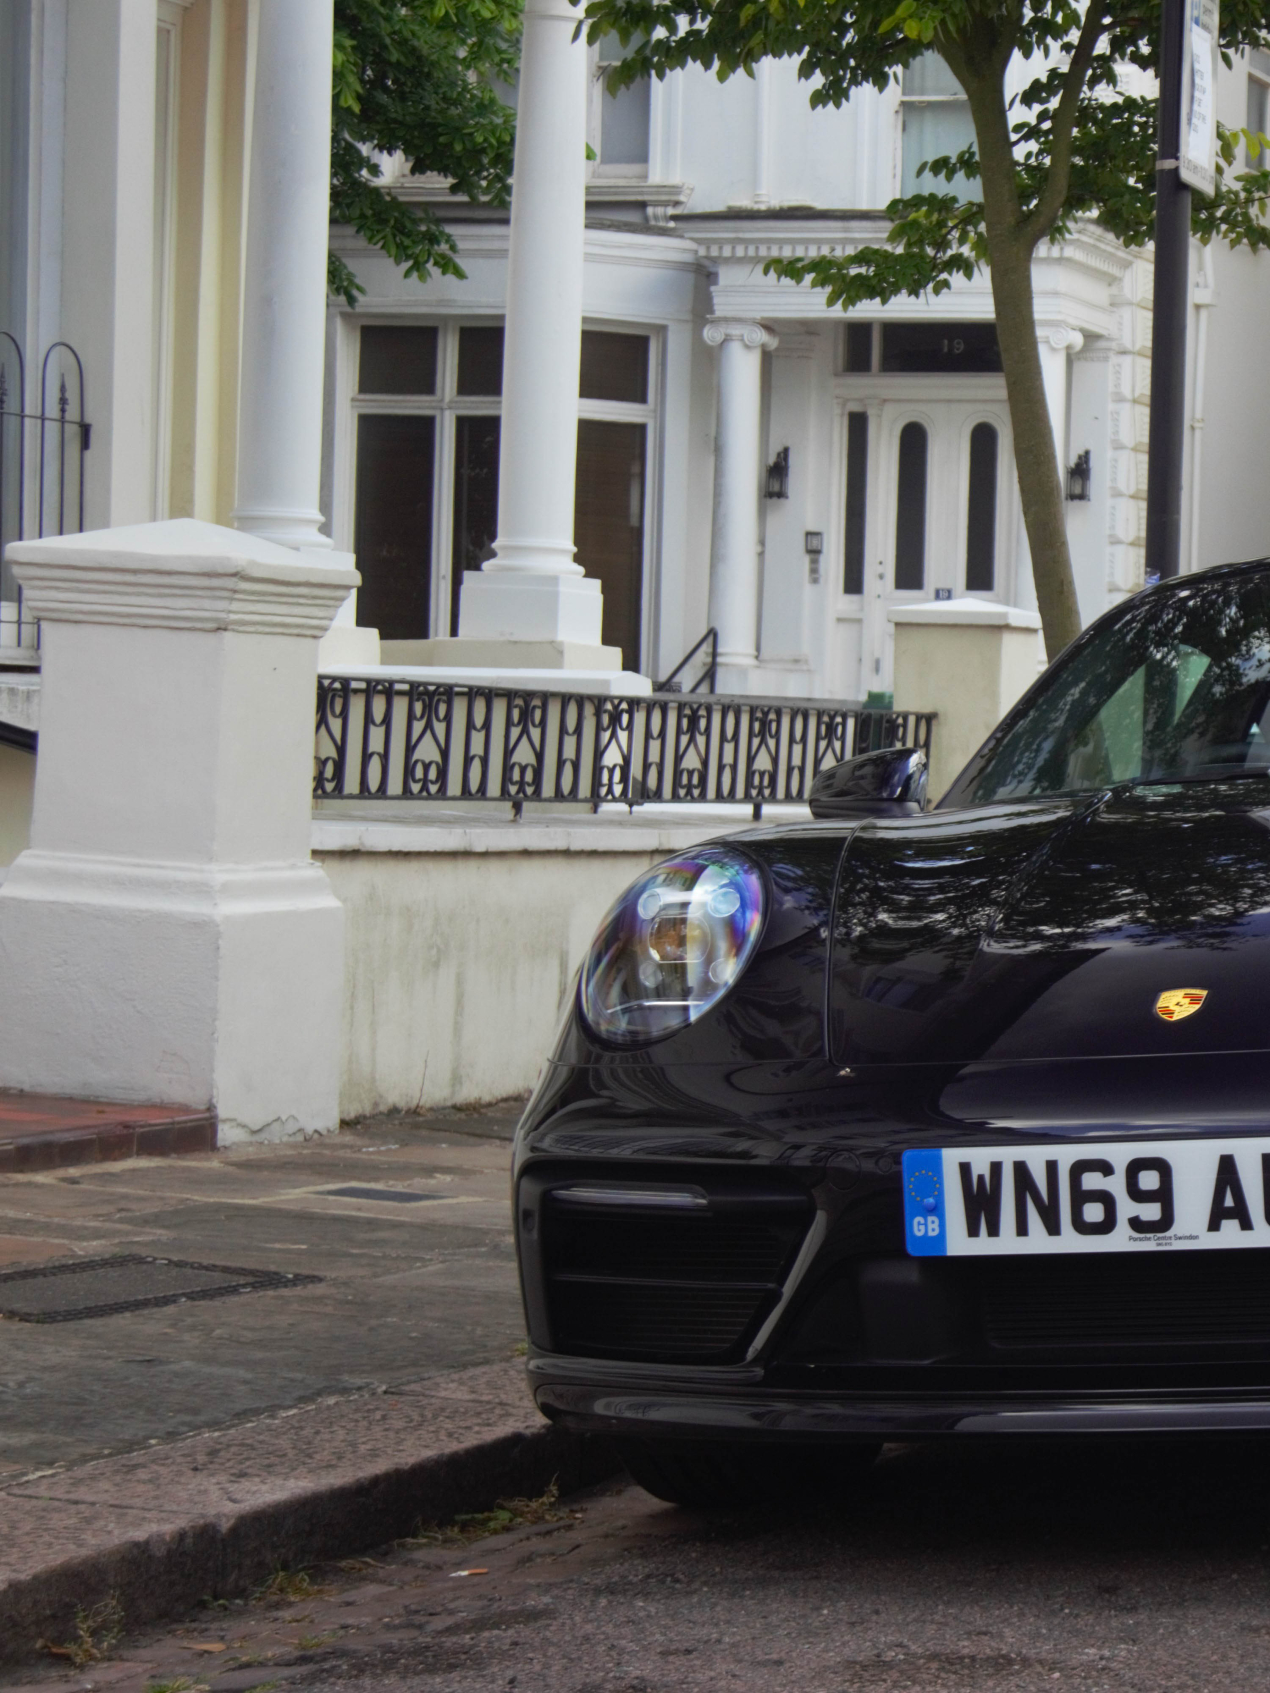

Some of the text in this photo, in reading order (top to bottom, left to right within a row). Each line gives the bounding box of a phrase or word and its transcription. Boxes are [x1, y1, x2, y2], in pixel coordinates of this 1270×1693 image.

[942, 339, 965, 354] 19
[958, 1157, 1175, 1238] WN69
[912, 1216, 940, 1237] GB
[1153, 1234, 1173, 1242] Centre
